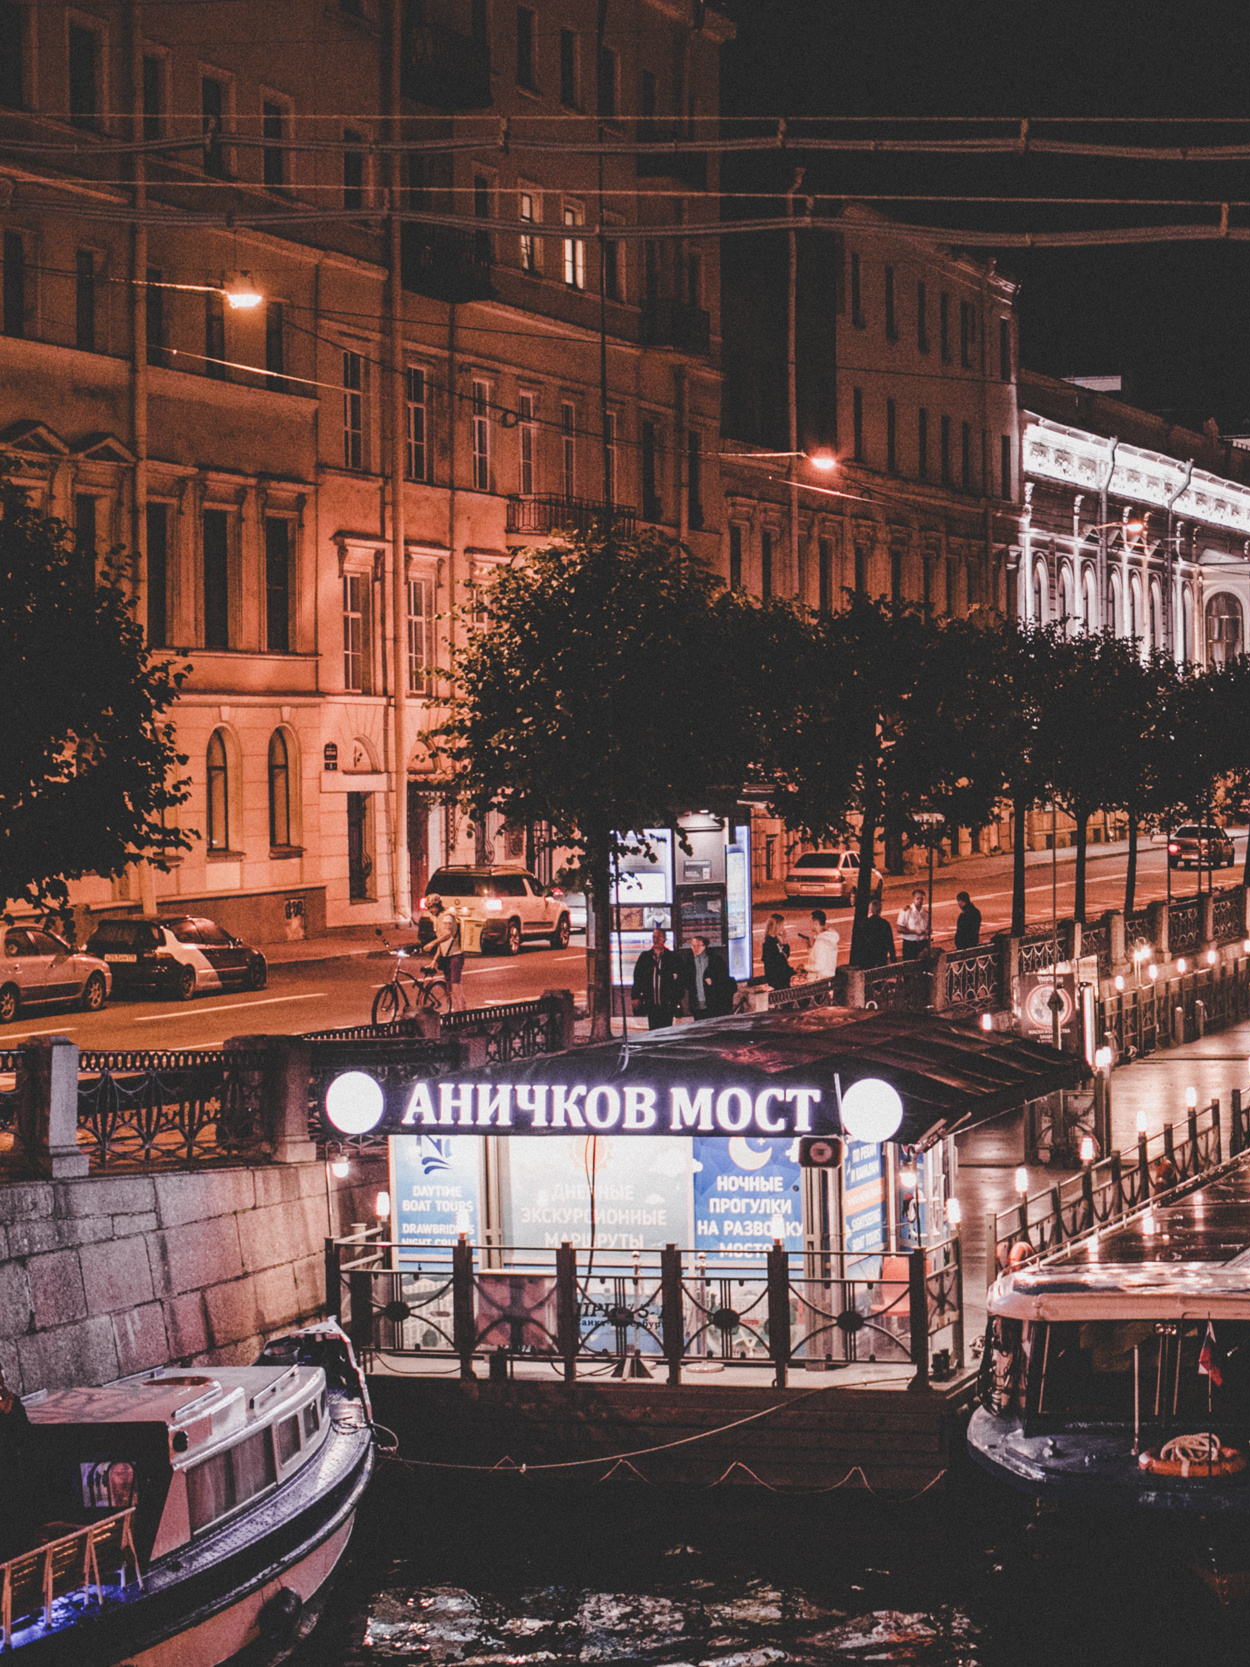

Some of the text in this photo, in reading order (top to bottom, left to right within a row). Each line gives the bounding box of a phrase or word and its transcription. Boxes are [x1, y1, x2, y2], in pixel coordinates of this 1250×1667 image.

[401, 1083, 821, 1132] АНИЧКОВ МОСТ
[412, 1185, 462, 1198] DAYTIME
[716, 1175, 784, 1192] НОЧНЫЕ
[402, 1199, 473, 1213] BOAT TOURS
[709, 1197, 792, 1215] ПРОГУЛКИ
[521, 1207, 668, 1226] ЭКСКУРСИОННЫЕ
[402, 1222, 475, 1235] DRAWBRIDS
[697, 1219, 803, 1237] НА РАЗВОКУ
[402, 1237, 477, 1247] NIGHT CRUIS
[719, 1242, 774, 1258] МОСТО
